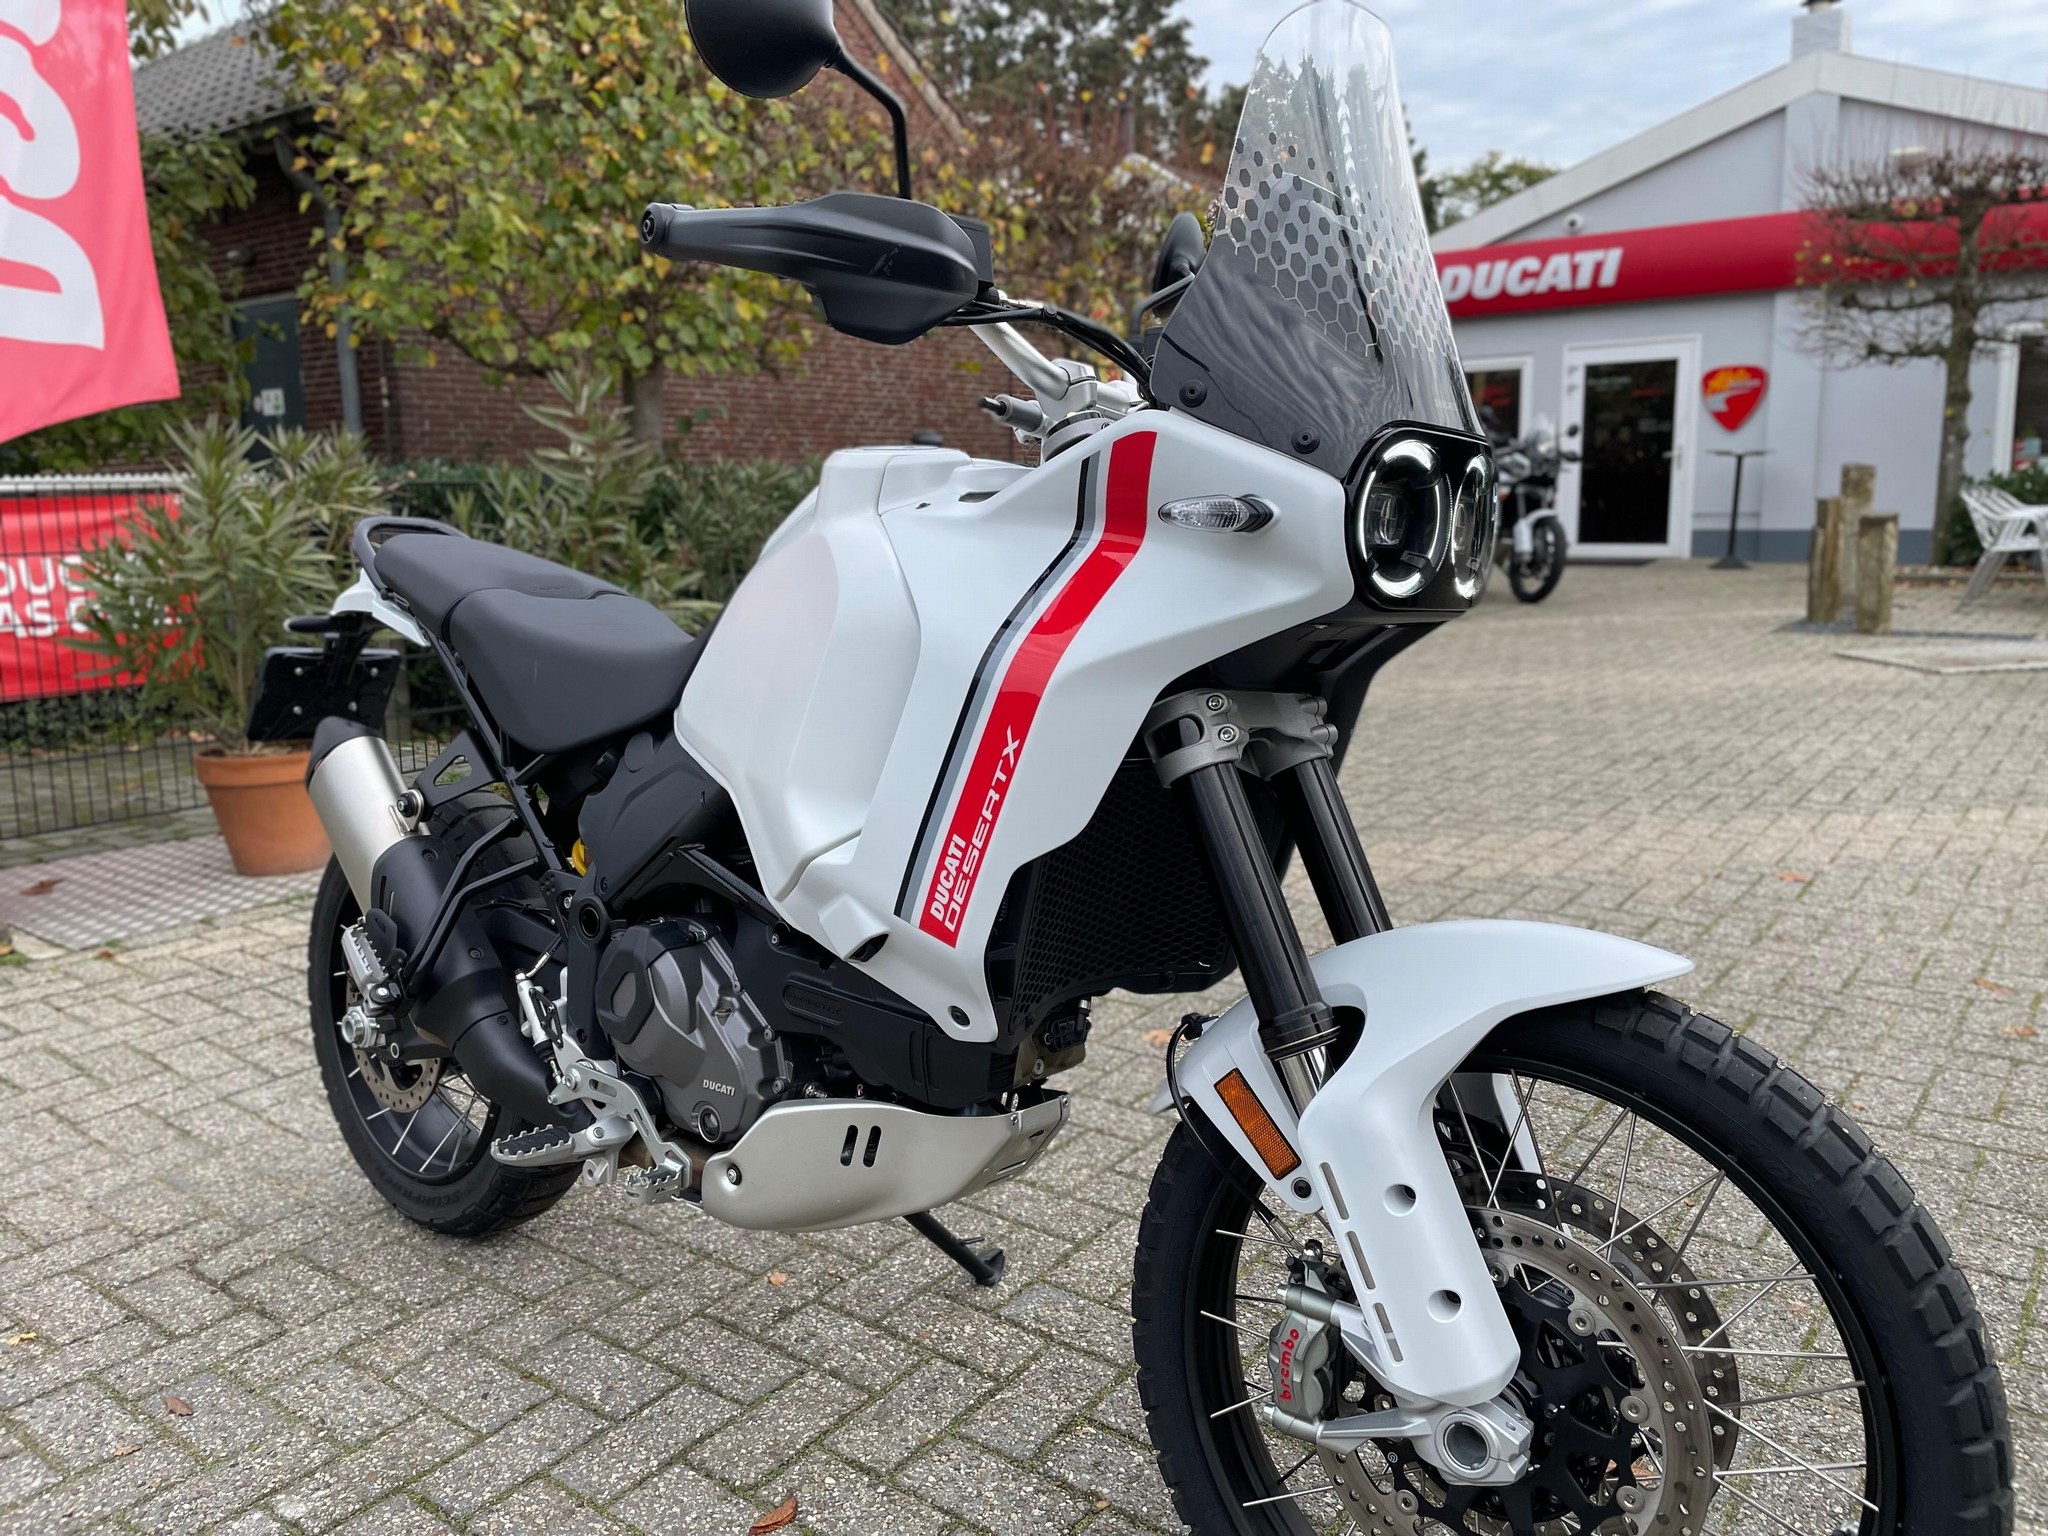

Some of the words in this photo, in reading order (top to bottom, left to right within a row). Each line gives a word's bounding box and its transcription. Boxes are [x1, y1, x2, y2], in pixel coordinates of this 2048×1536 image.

[1440, 246, 1624, 303] DUCATI
[944, 724, 1021, 933] DESERTX
[930, 833, 966, 922] DUCATI
[702, 1079, 735, 1097] DUCATI
[1280, 1328, 1300, 1400] brembo
